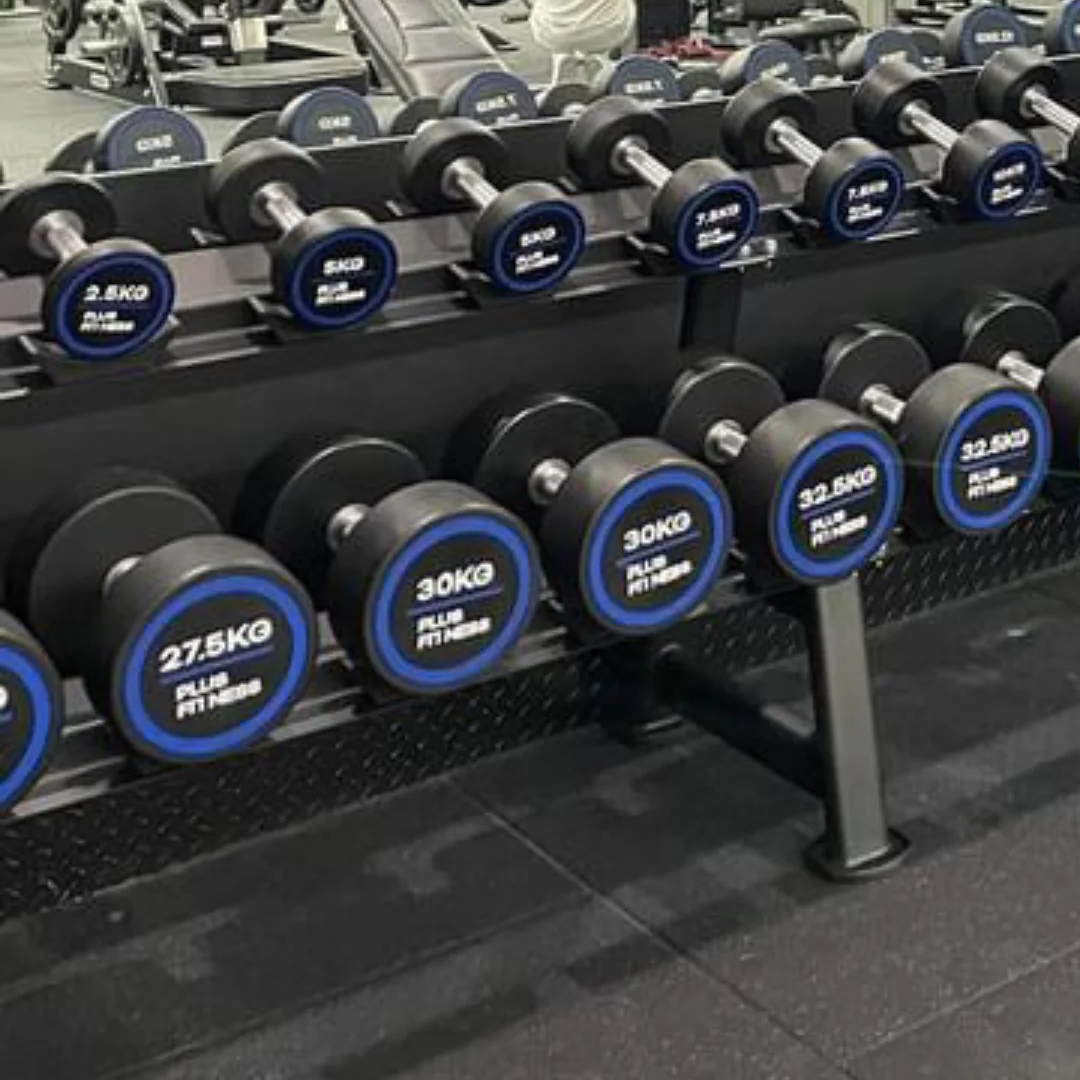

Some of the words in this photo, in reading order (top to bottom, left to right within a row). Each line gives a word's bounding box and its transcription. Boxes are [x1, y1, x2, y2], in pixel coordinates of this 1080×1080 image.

[83, 283, 150, 302] 2.5KG
[960, 427, 1030, 461] 32.5KG
[798, 464, 878, 511] 32.5KG
[623, 511, 693, 552] 30KG
[416, 562, 495, 601] 30KG
[158, 616, 273, 673] 27.5KG
[175, 671, 229, 701] PLUS
